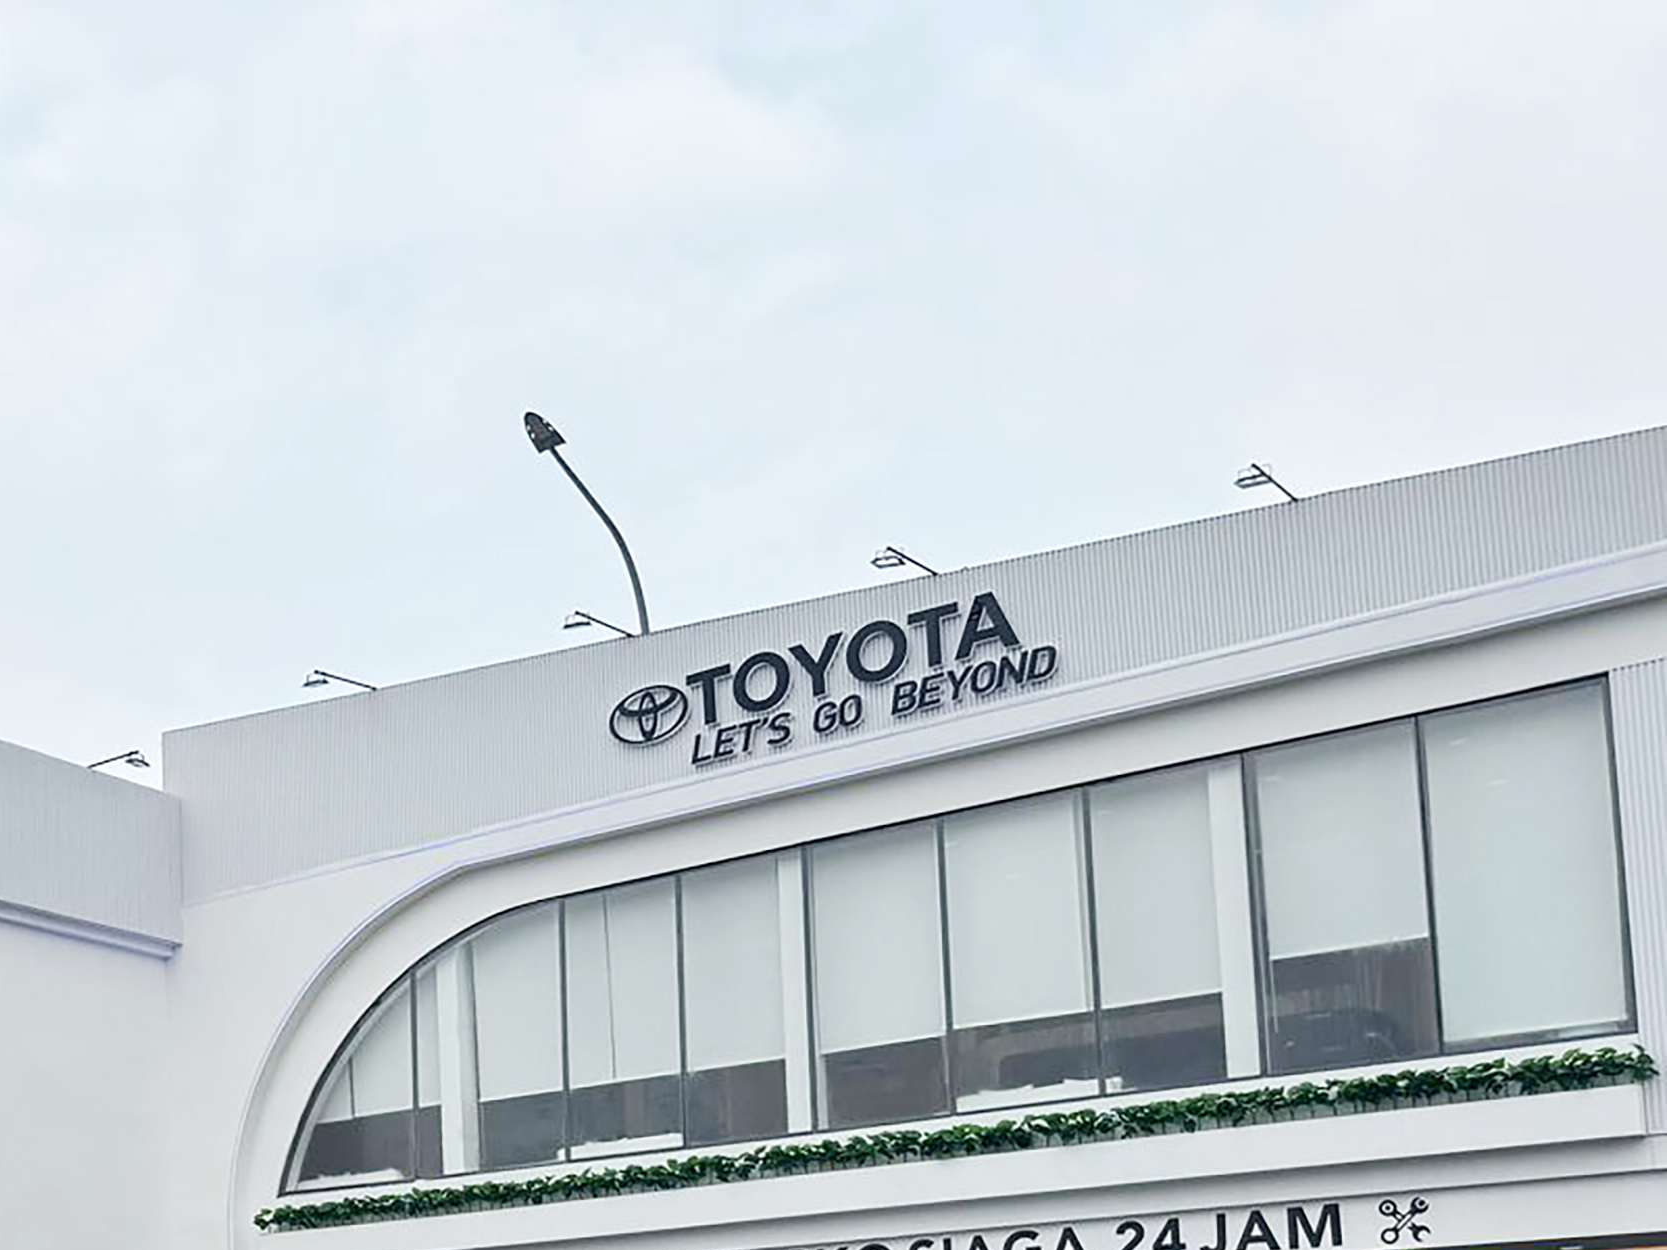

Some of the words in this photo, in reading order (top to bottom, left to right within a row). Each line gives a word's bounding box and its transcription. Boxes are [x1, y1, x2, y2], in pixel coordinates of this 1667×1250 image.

[686, 590, 1021, 725] TOYOTA
[691, 711, 791, 765] LET'S
[813, 694, 862, 733] GO
[891, 645, 1057, 715] BEYOND
